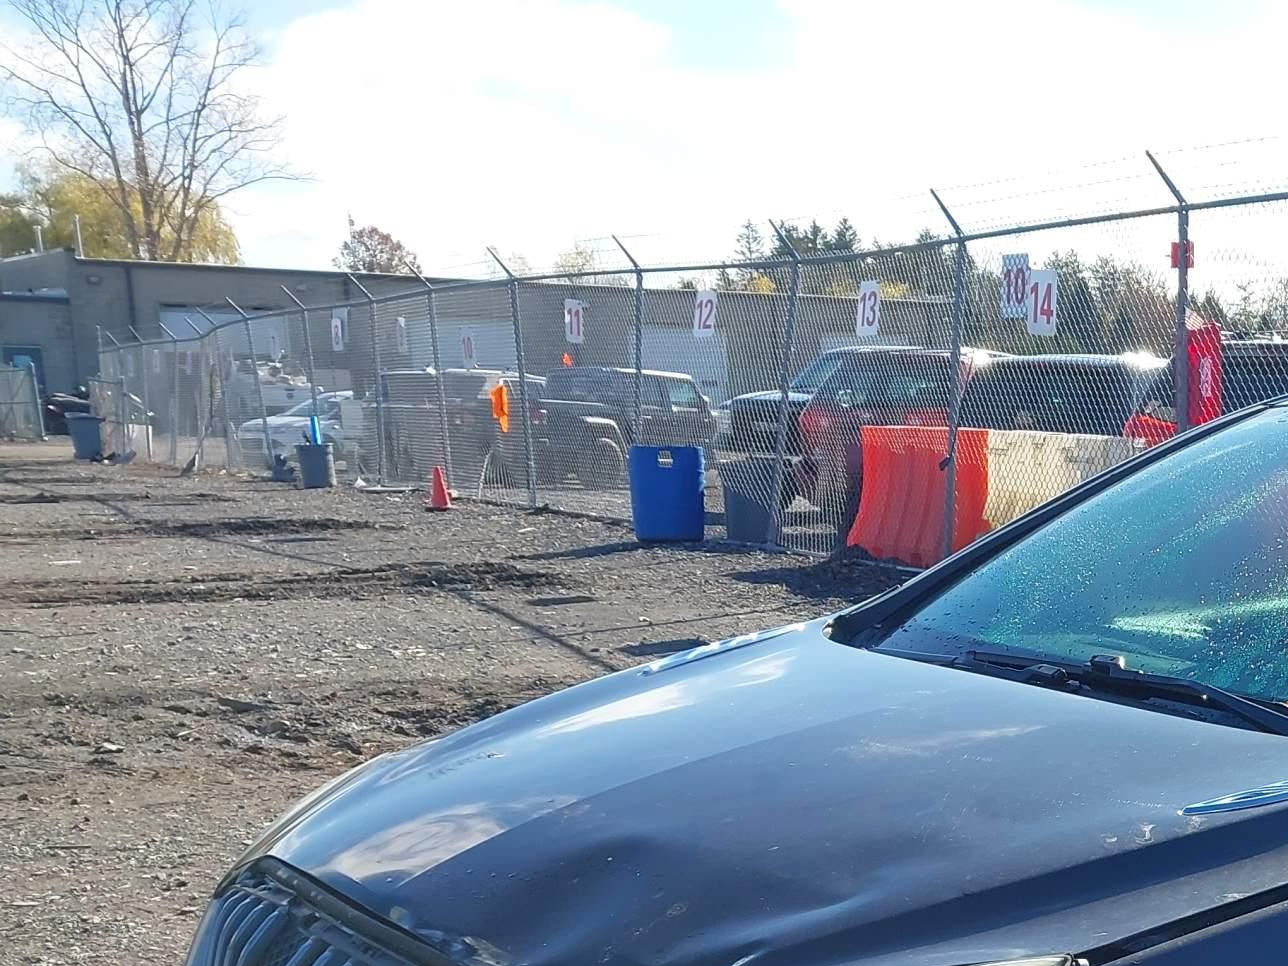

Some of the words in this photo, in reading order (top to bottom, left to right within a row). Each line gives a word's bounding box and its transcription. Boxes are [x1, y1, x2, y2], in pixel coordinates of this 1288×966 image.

[1003, 267, 1026, 305] 10
[1030, 281, 1054, 325] 14
[567, 307, 581, 337] 11
[696, 299, 714, 330] 12
[859, 290, 877, 327] 13
